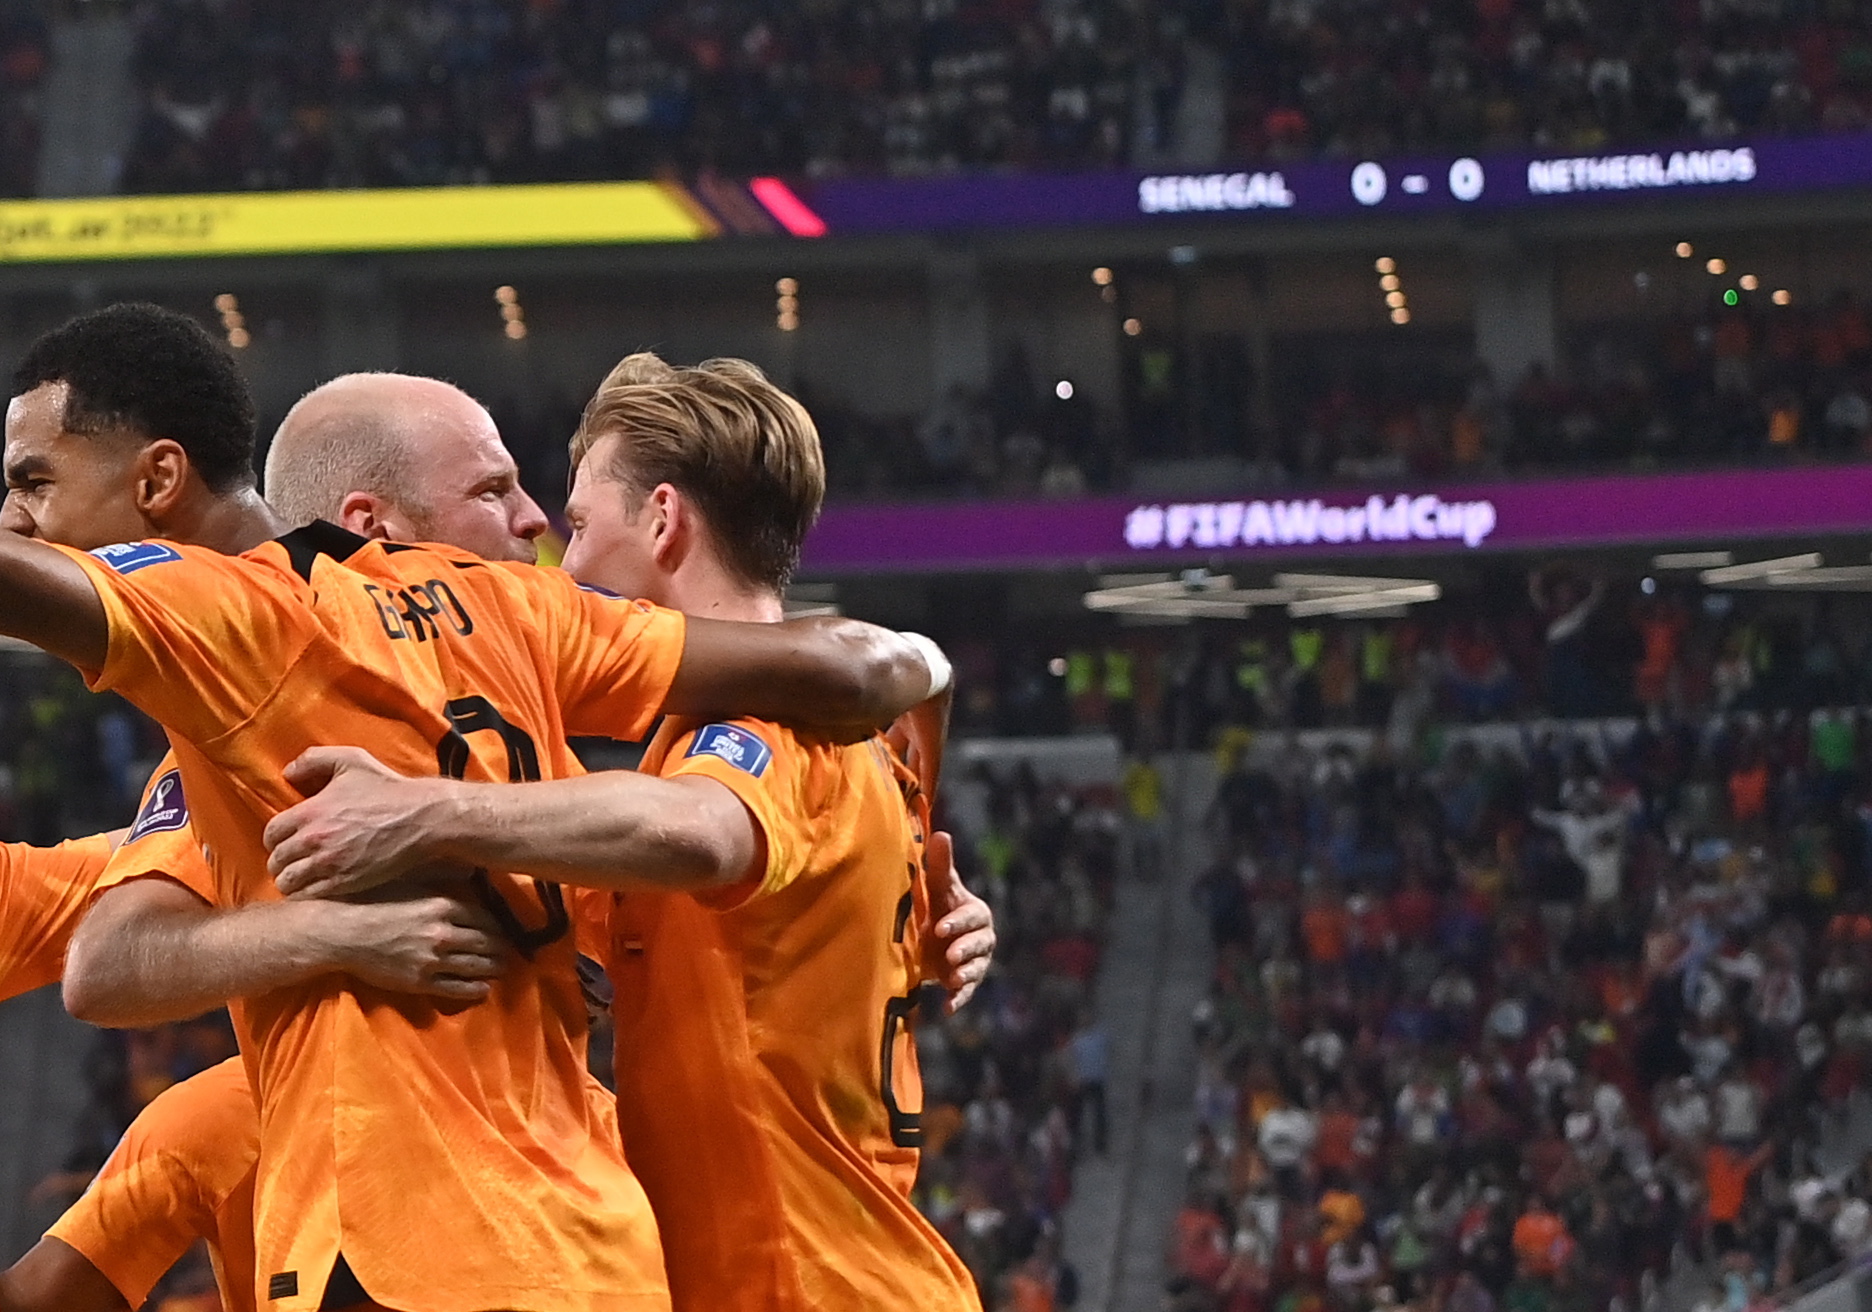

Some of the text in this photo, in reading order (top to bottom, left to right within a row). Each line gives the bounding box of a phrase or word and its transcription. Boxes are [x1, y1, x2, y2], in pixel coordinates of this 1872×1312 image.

[1138, 171, 1295, 214] SENEGAL
[1350, 161, 1388, 206] 0
[1449, 157, 1485, 201] 0
[1528, 147, 1756, 194] NETHERLANDS
[1125, 495, 1496, 547] #FIFAWorldCup
